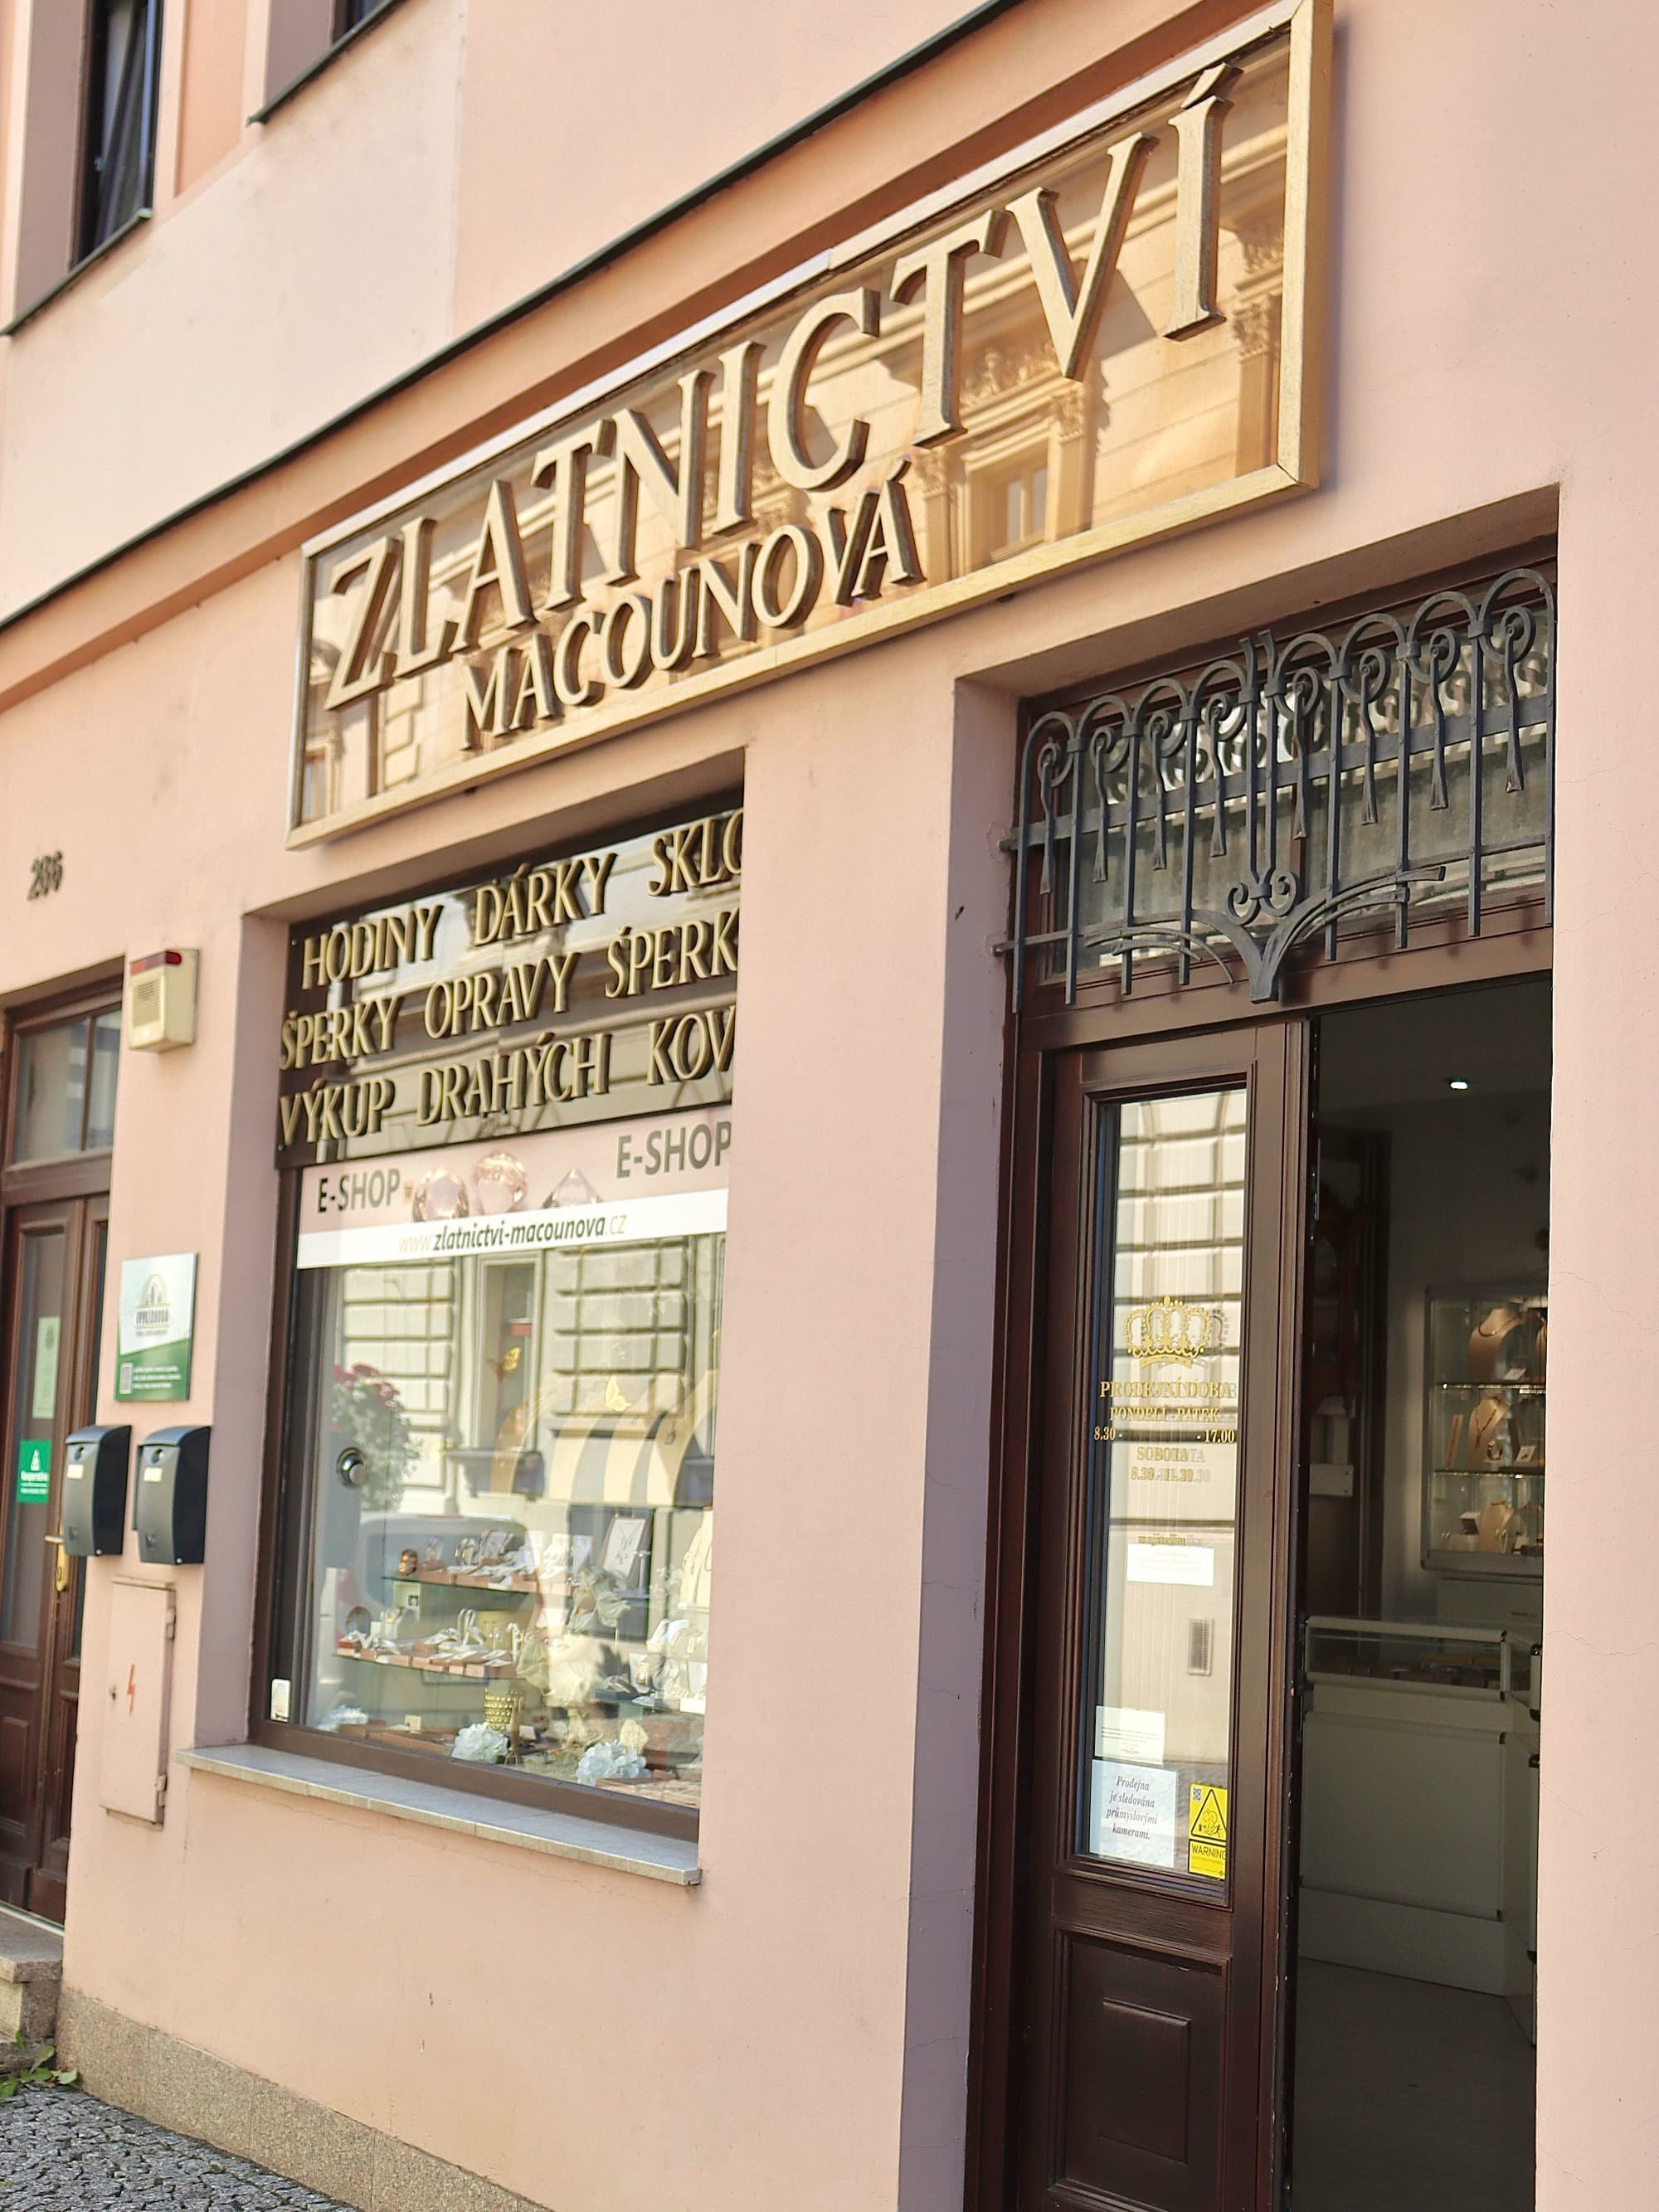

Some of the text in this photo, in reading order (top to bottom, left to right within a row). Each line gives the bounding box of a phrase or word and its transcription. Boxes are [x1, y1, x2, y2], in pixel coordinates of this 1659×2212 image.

[326, 61, 1243, 711] ZLATNICTVÍ
[460, 458, 927, 751] MACOUNOVÁ
[301, 903, 444, 991] HODINY
[474, 853, 617, 946] DÁRKY
[280, 994, 403, 1072] ŠPERKY
[425, 951, 584, 1039] OPRAVY
[280, 1077, 395, 1145] VÝKUP
[416, 1031, 613, 1126] DRAHÝCH
[317, 1121, 732, 1214] E-SHOP E-SHOP
[1093, 1426, 1116, 1441] 8.30
[1204, 1429, 1235, 1443] 17.00
[1136, 1446, 1189, 1462] SOBOTA
[1106, 1806, 1158, 1826] průmyslovými
[1108, 1791, 1155, 1808] je sledována
[1116, 1775, 1151, 1792] Prodejna
